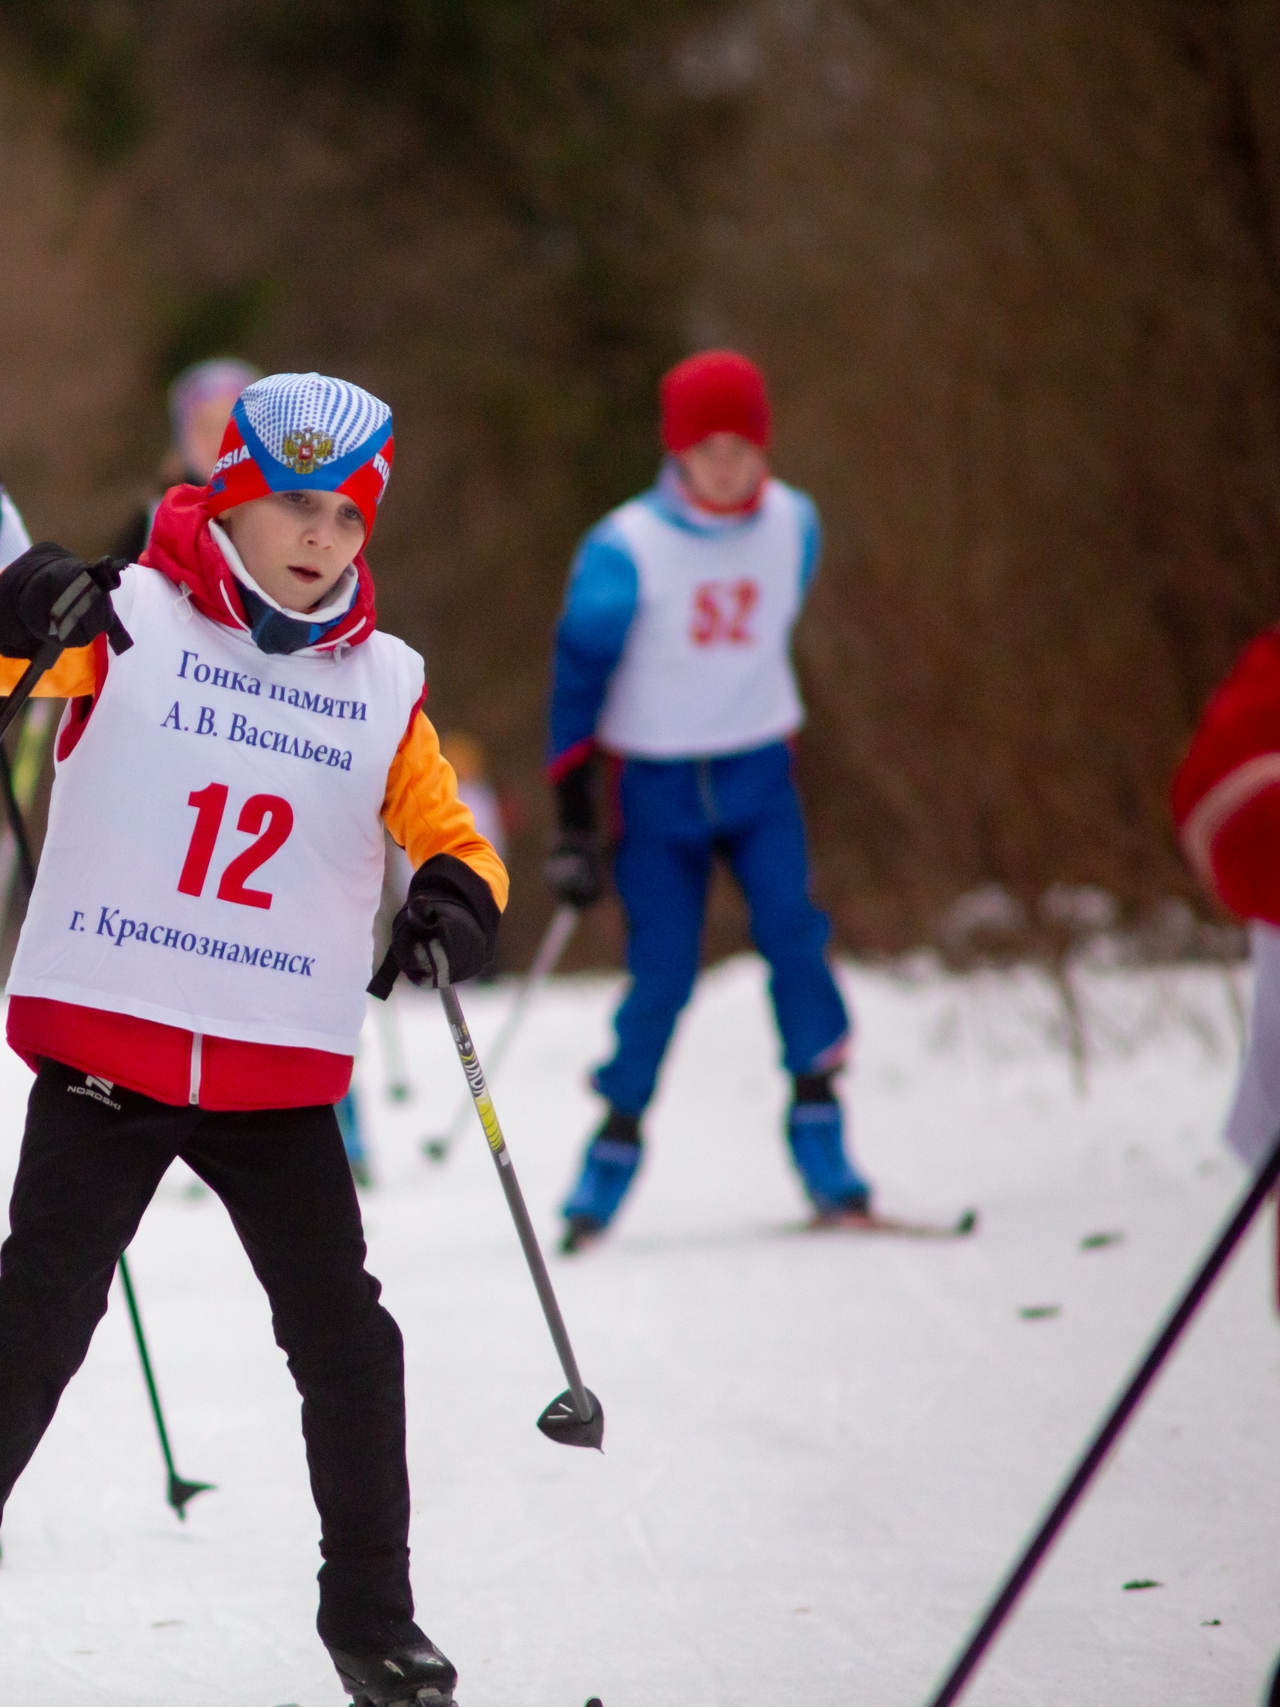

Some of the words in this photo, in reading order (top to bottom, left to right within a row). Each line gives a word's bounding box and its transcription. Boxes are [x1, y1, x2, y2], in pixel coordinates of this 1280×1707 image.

[688, 577, 760, 650] 52
[177, 649, 262, 696] Гонка
[268, 683, 368, 721] памяти
[160, 701, 189, 732] А.
[194, 706, 219, 737] В.
[227, 713, 353, 772] Васильева
[176, 781, 295, 911] 12
[68, 910, 86, 932] г.
[95, 906, 317, 977] Краснознаменск
[66, 1085, 122, 1111] NORDSKI
